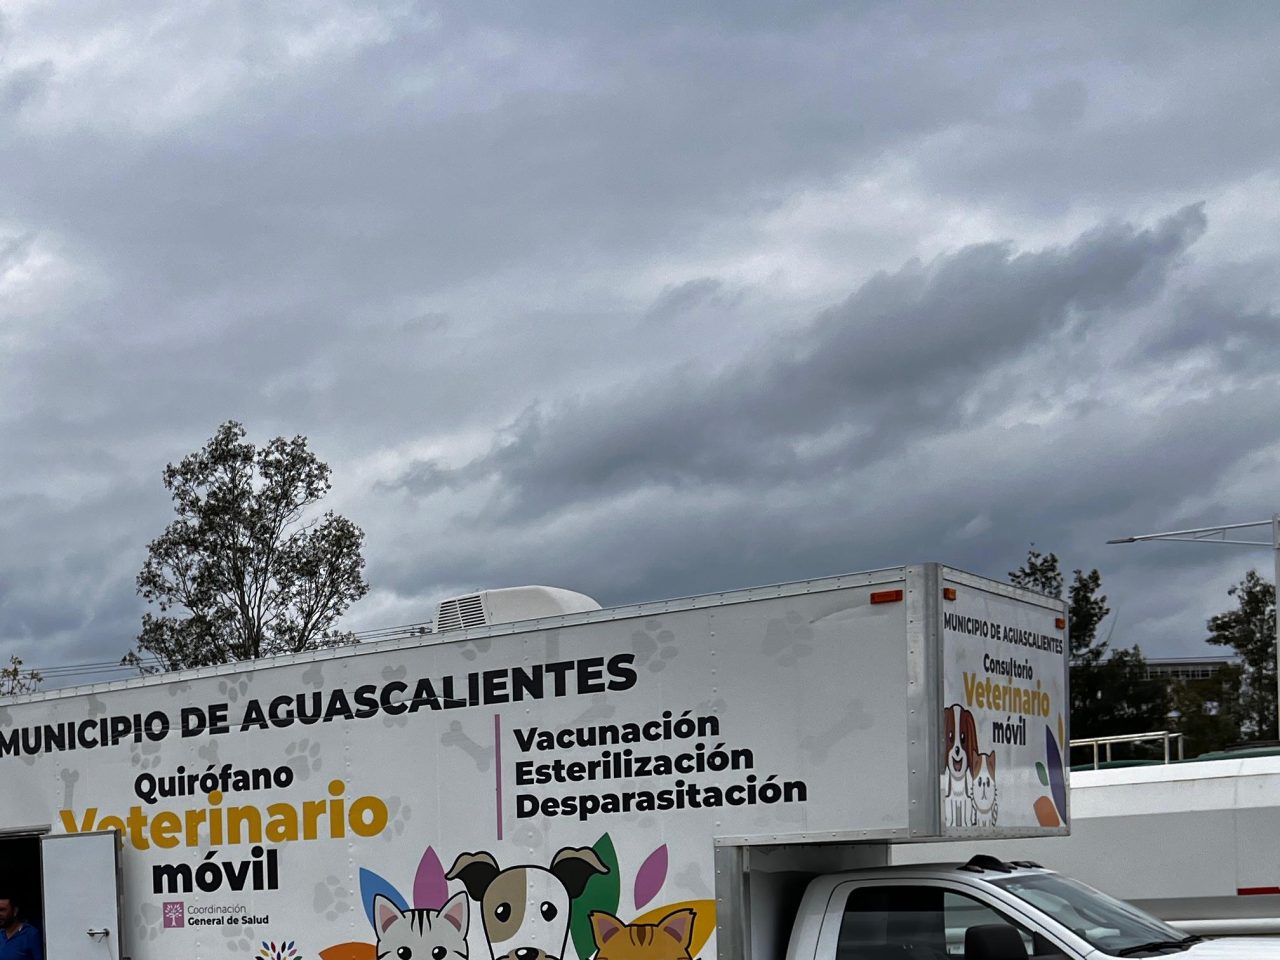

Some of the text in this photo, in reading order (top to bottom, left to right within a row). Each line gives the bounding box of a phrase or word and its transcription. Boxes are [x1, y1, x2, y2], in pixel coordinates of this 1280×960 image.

[944, 612, 1063, 654] MUNICIPIO DE AGUASCALIENTES
[983, 653, 1033, 680] Consultorio
[180, 702, 231, 739] DE
[239, 653, 639, 732] AGUASCALIENTES
[962, 671, 1050, 718] Veterinario
[512, 709, 720, 752] Vacunación
[992, 715, 1026, 746] móvil
[134, 763, 295, 805] Quirófano
[515, 742, 754, 786] Esterilización
[516, 774, 808, 821] Desparasitación
[152, 845, 279, 895] móvil
[187, 903, 247, 915] Coordinación
[187, 914, 269, 926] General de Salud
